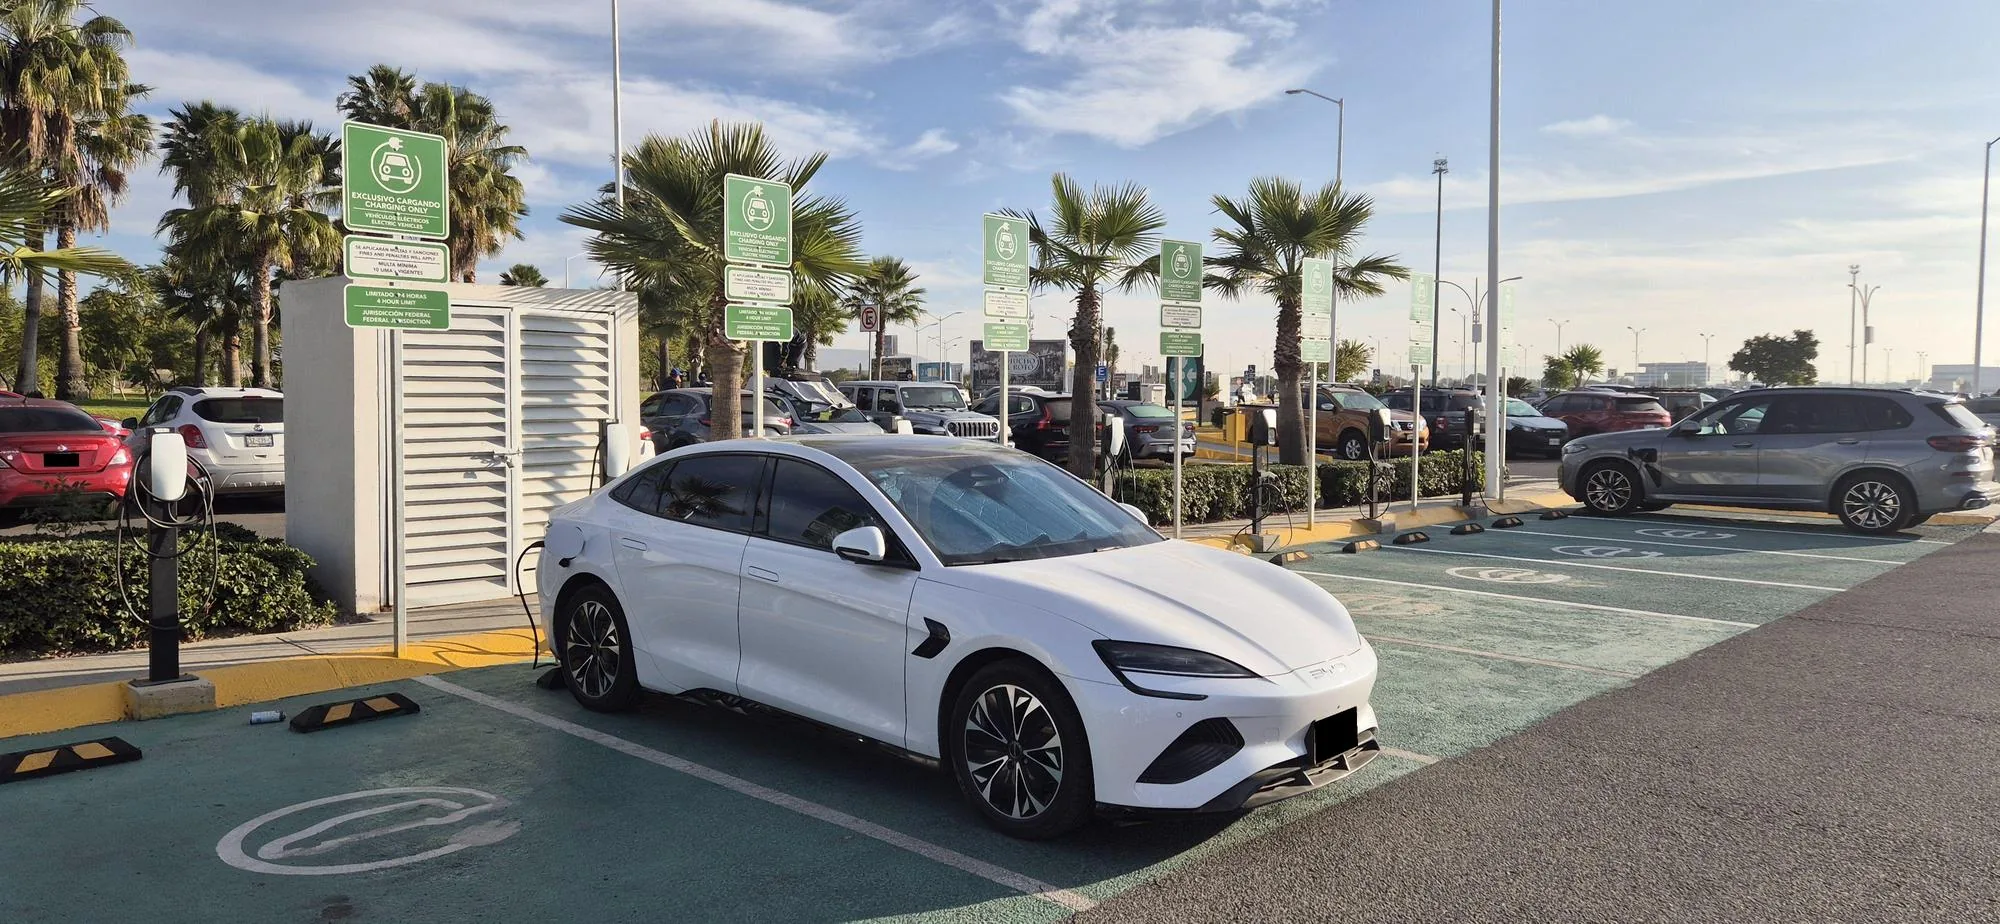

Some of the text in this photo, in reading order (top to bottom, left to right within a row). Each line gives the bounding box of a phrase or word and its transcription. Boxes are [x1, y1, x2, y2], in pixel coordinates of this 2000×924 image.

[352, 192, 440, 208] EXCLUSIVO CARGANDO
[365, 201, 428, 214] CHARGING ONLY
[365, 212, 429, 224] VEHÍCULOS ELÉCTRICOS
[730, 231, 787, 242] EXCLUSIVO CARGANDO
